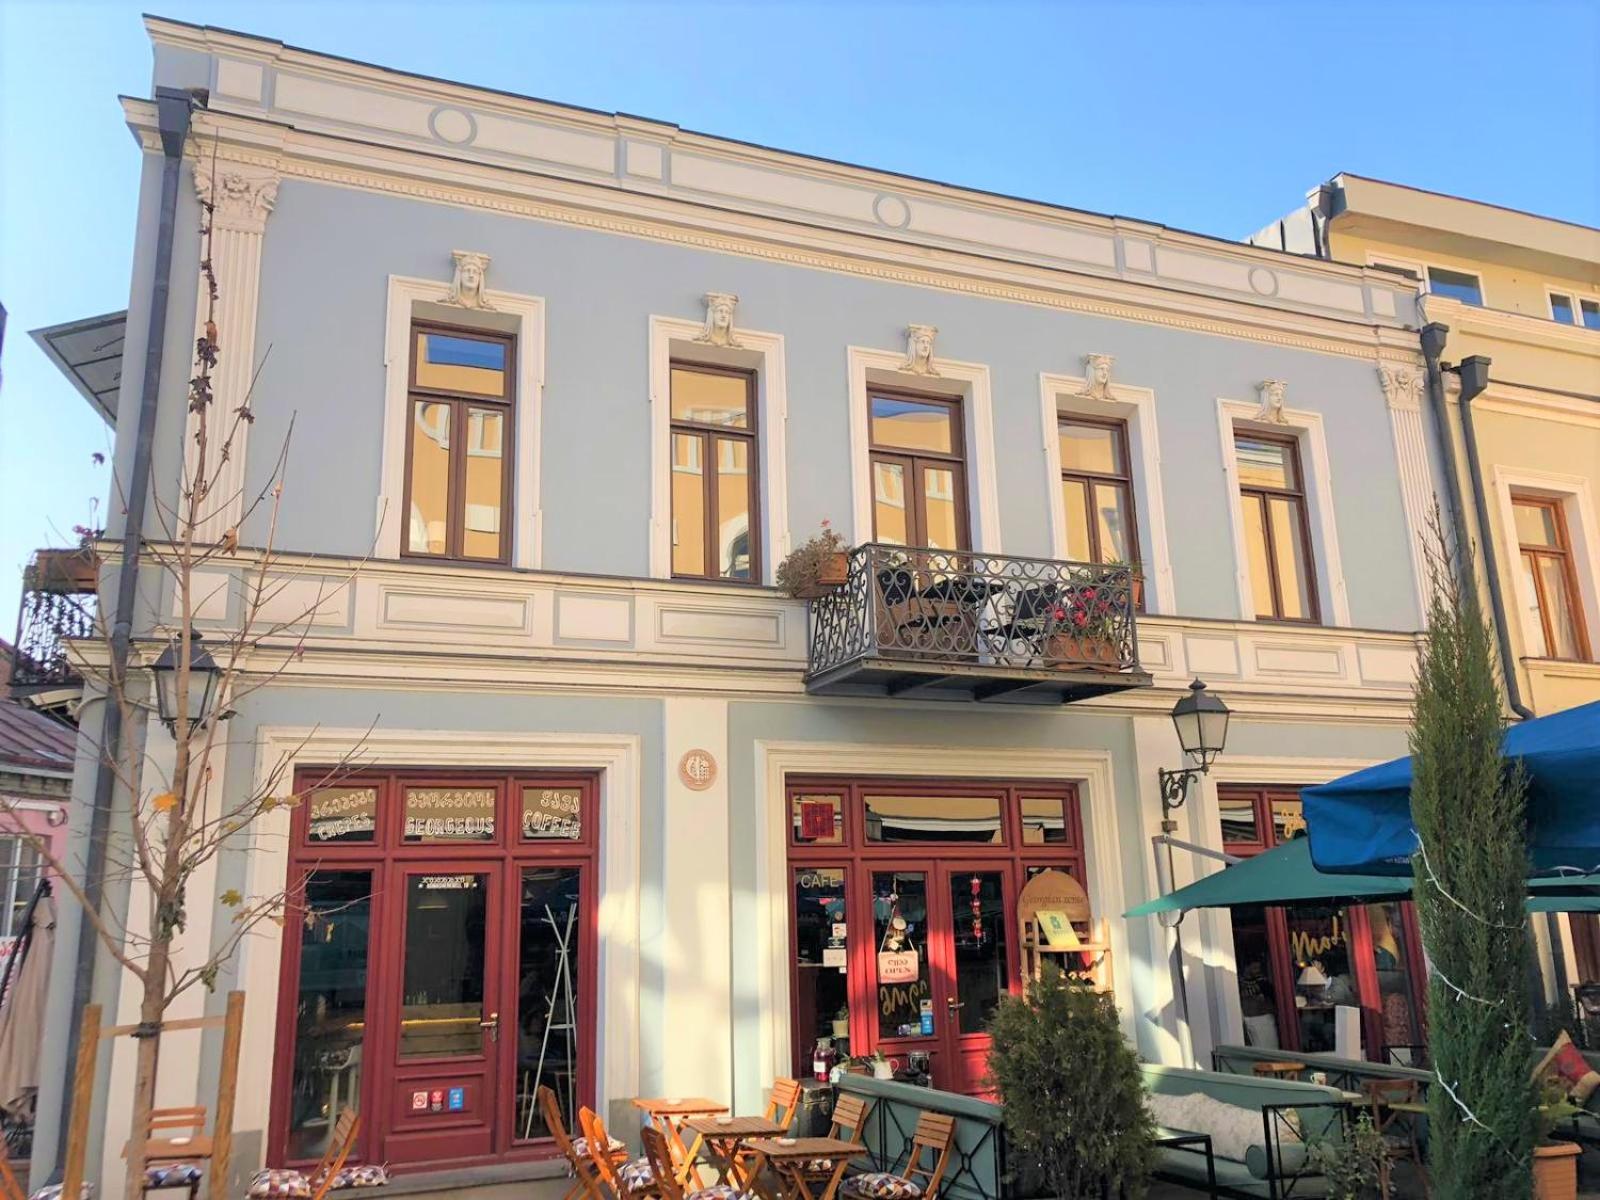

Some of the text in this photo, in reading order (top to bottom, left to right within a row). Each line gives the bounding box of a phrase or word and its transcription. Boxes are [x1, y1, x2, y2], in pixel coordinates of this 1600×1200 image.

[317, 811, 371, 840] CREPES
[406, 816, 495, 836] GEORGEOUS
[522, 809, 582, 840] COFFEE
[884, 967, 912, 975] OPEN
